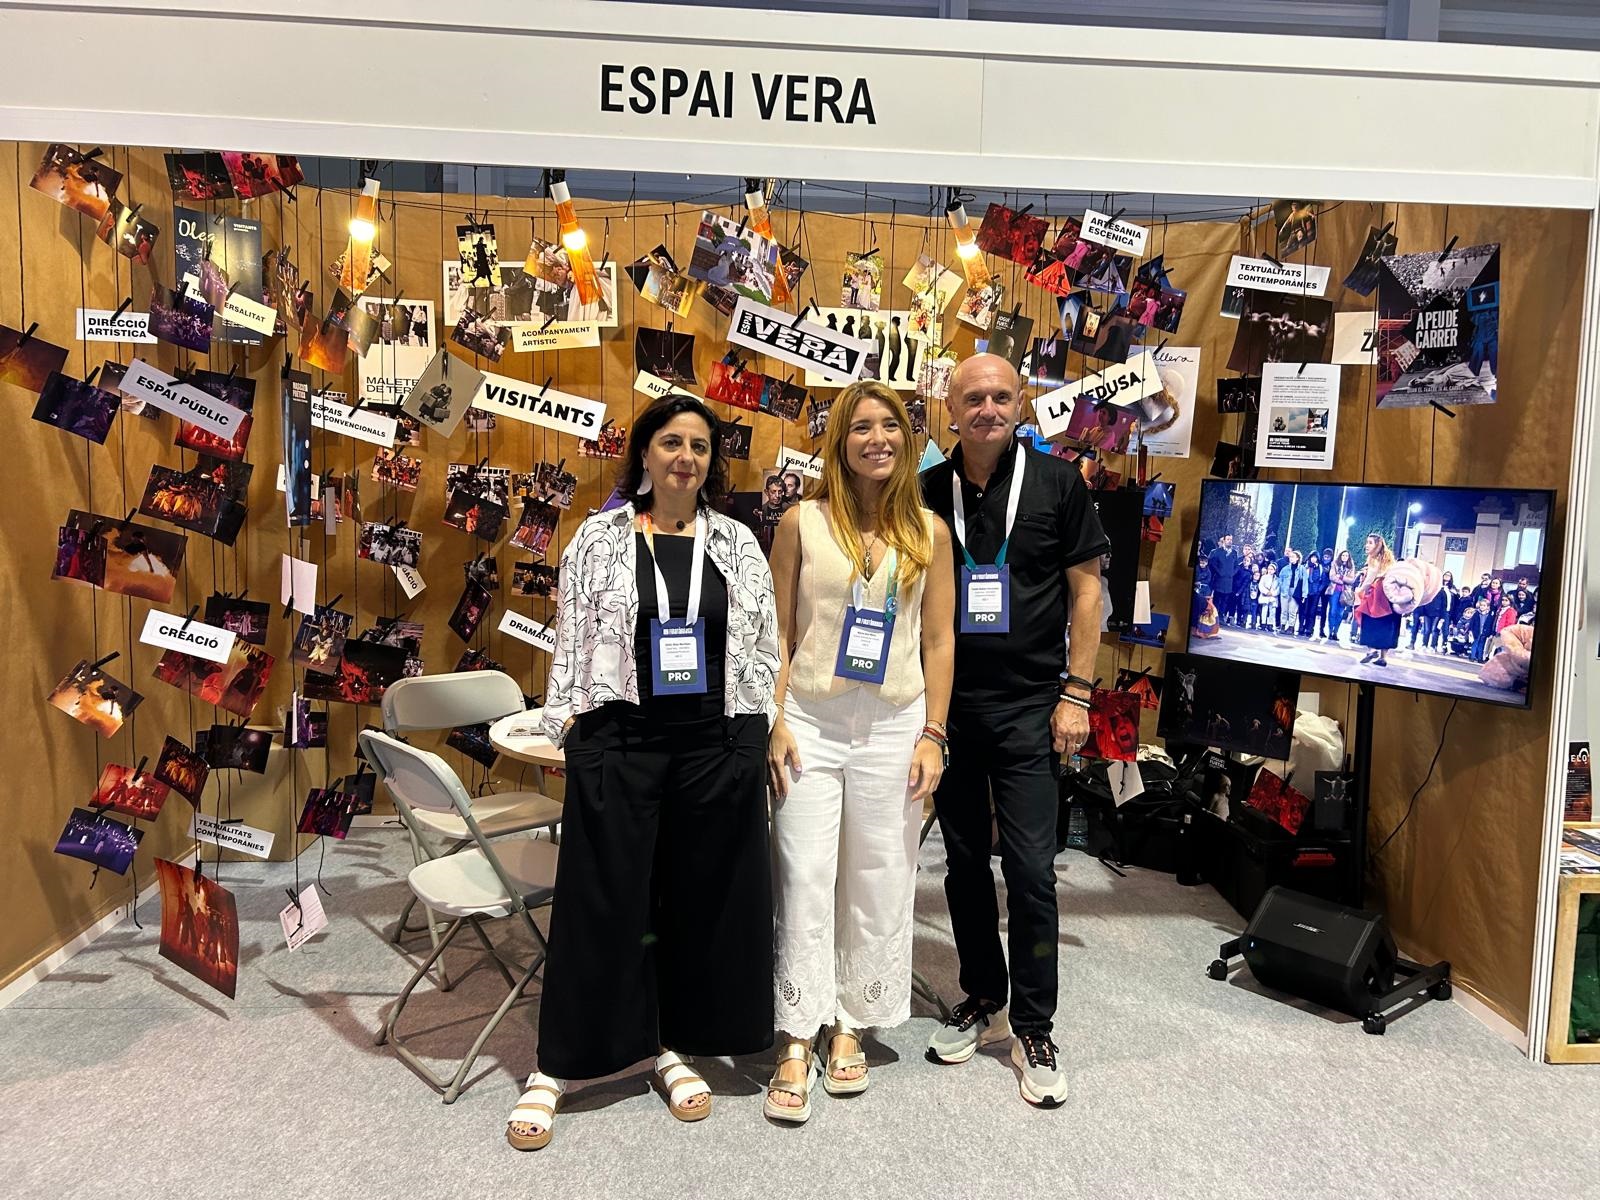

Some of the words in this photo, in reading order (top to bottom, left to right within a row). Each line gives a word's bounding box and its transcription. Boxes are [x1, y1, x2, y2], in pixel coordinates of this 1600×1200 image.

[601, 64, 733, 118] ESPAI
[751, 72, 876, 125] VERA
[1090, 216, 1142, 239] ARTESANIA
[1239, 263, 1302, 278] TEXTUALITATS
[87, 316, 147, 329] DIRECCIÓ
[741, 312, 754, 334] ESPAI
[1416, 312, 1424, 330] A
[1425, 310, 1444, 329] PEU
[1446, 309, 1459, 328] DE
[521, 326, 591, 337] ACOMPANYAMENT
[1415, 328, 1458, 349] CARRER
[754, 316, 848, 371] VERA
[136, 375, 178, 402] ESPAI
[179, 395, 229, 425] PÚBLIC
[366, 385, 383, 393] DE
[386, 385, 414, 394] TER
[1048, 401, 1071, 419] LA
[1072, 371, 1146, 404] EDUSA.
[312, 402, 343, 417] ESPAIS
[485, 383, 596, 428] VISITANTS
[311, 411, 321, 419] NO
[323, 414, 386, 438] CONVENCIONALS
[785, 456, 808, 468] ESPAI
[975, 613, 996, 622] PRO
[158, 624, 219, 649] CREACIÓ
[852, 658, 874, 670] PRO
[667, 671, 691, 682] PRO
[198, 818, 253, 839] TEXTUALITATS
